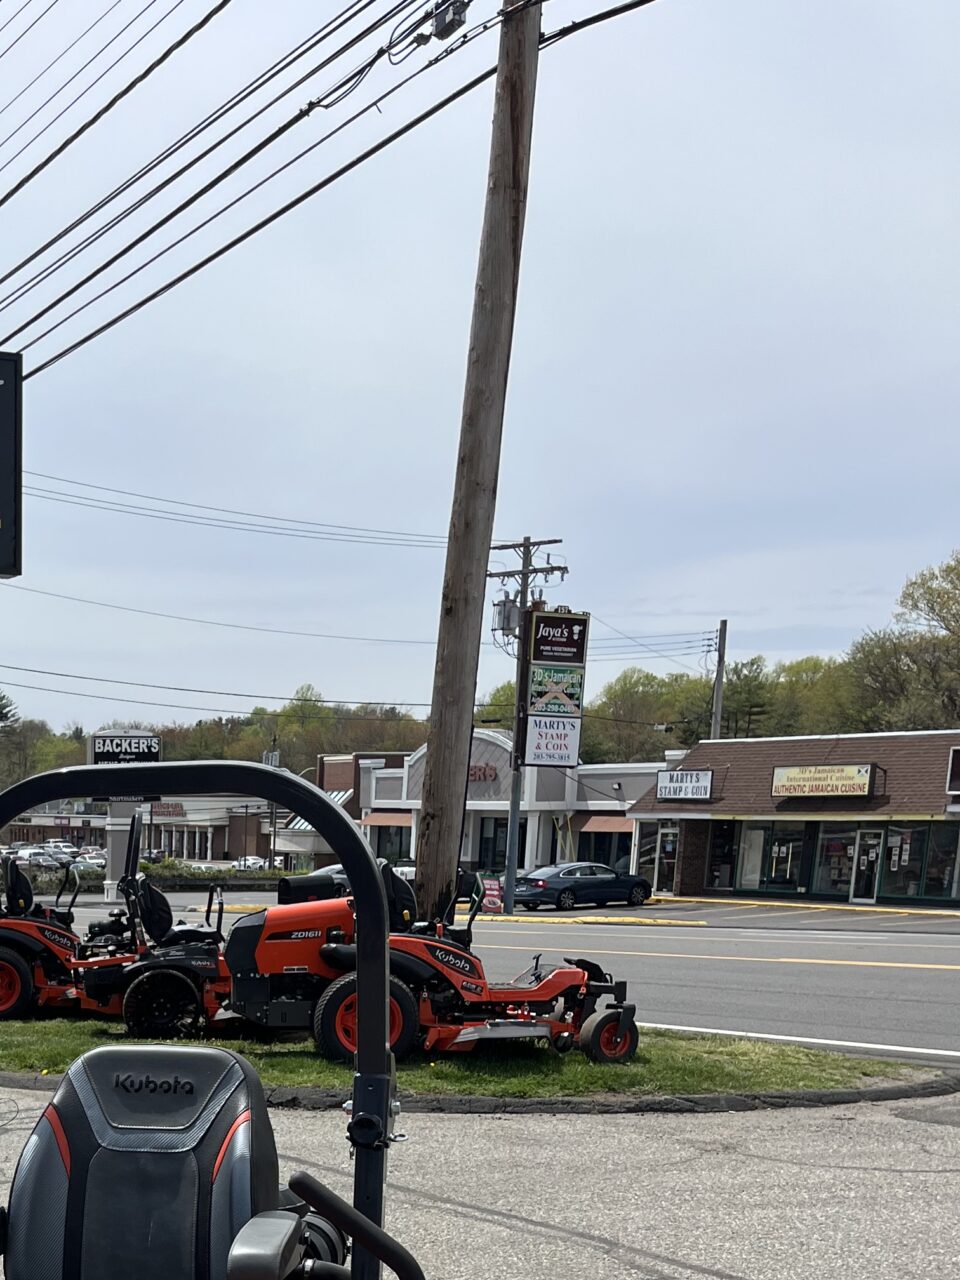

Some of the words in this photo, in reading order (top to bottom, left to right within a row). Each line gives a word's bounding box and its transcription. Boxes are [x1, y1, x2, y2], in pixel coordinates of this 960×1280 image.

[536, 623, 569, 640] Jaya's
[533, 669, 548, 681] 3D's
[551, 669, 581, 683] Jamaican
[533, 719, 576, 731] MARTY'S
[95, 738, 159, 753] BACKER'S
[535, 743, 542, 751] &
[830, 774, 855, 782] Cuisine
[659, 786, 683, 796] STAMP
[691, 786, 708, 796] COIN
[774, 784, 807, 794] AUTHENTIC
[808, 784, 840, 793] JAMAICAN
[840, 783, 867, 793] CUISINE
[44, 929, 71, 947] Kubota
[291, 930, 321, 939] ZD1611
[436, 949, 470, 971] Kubota
[114, 1074, 194, 1095] Kubota
